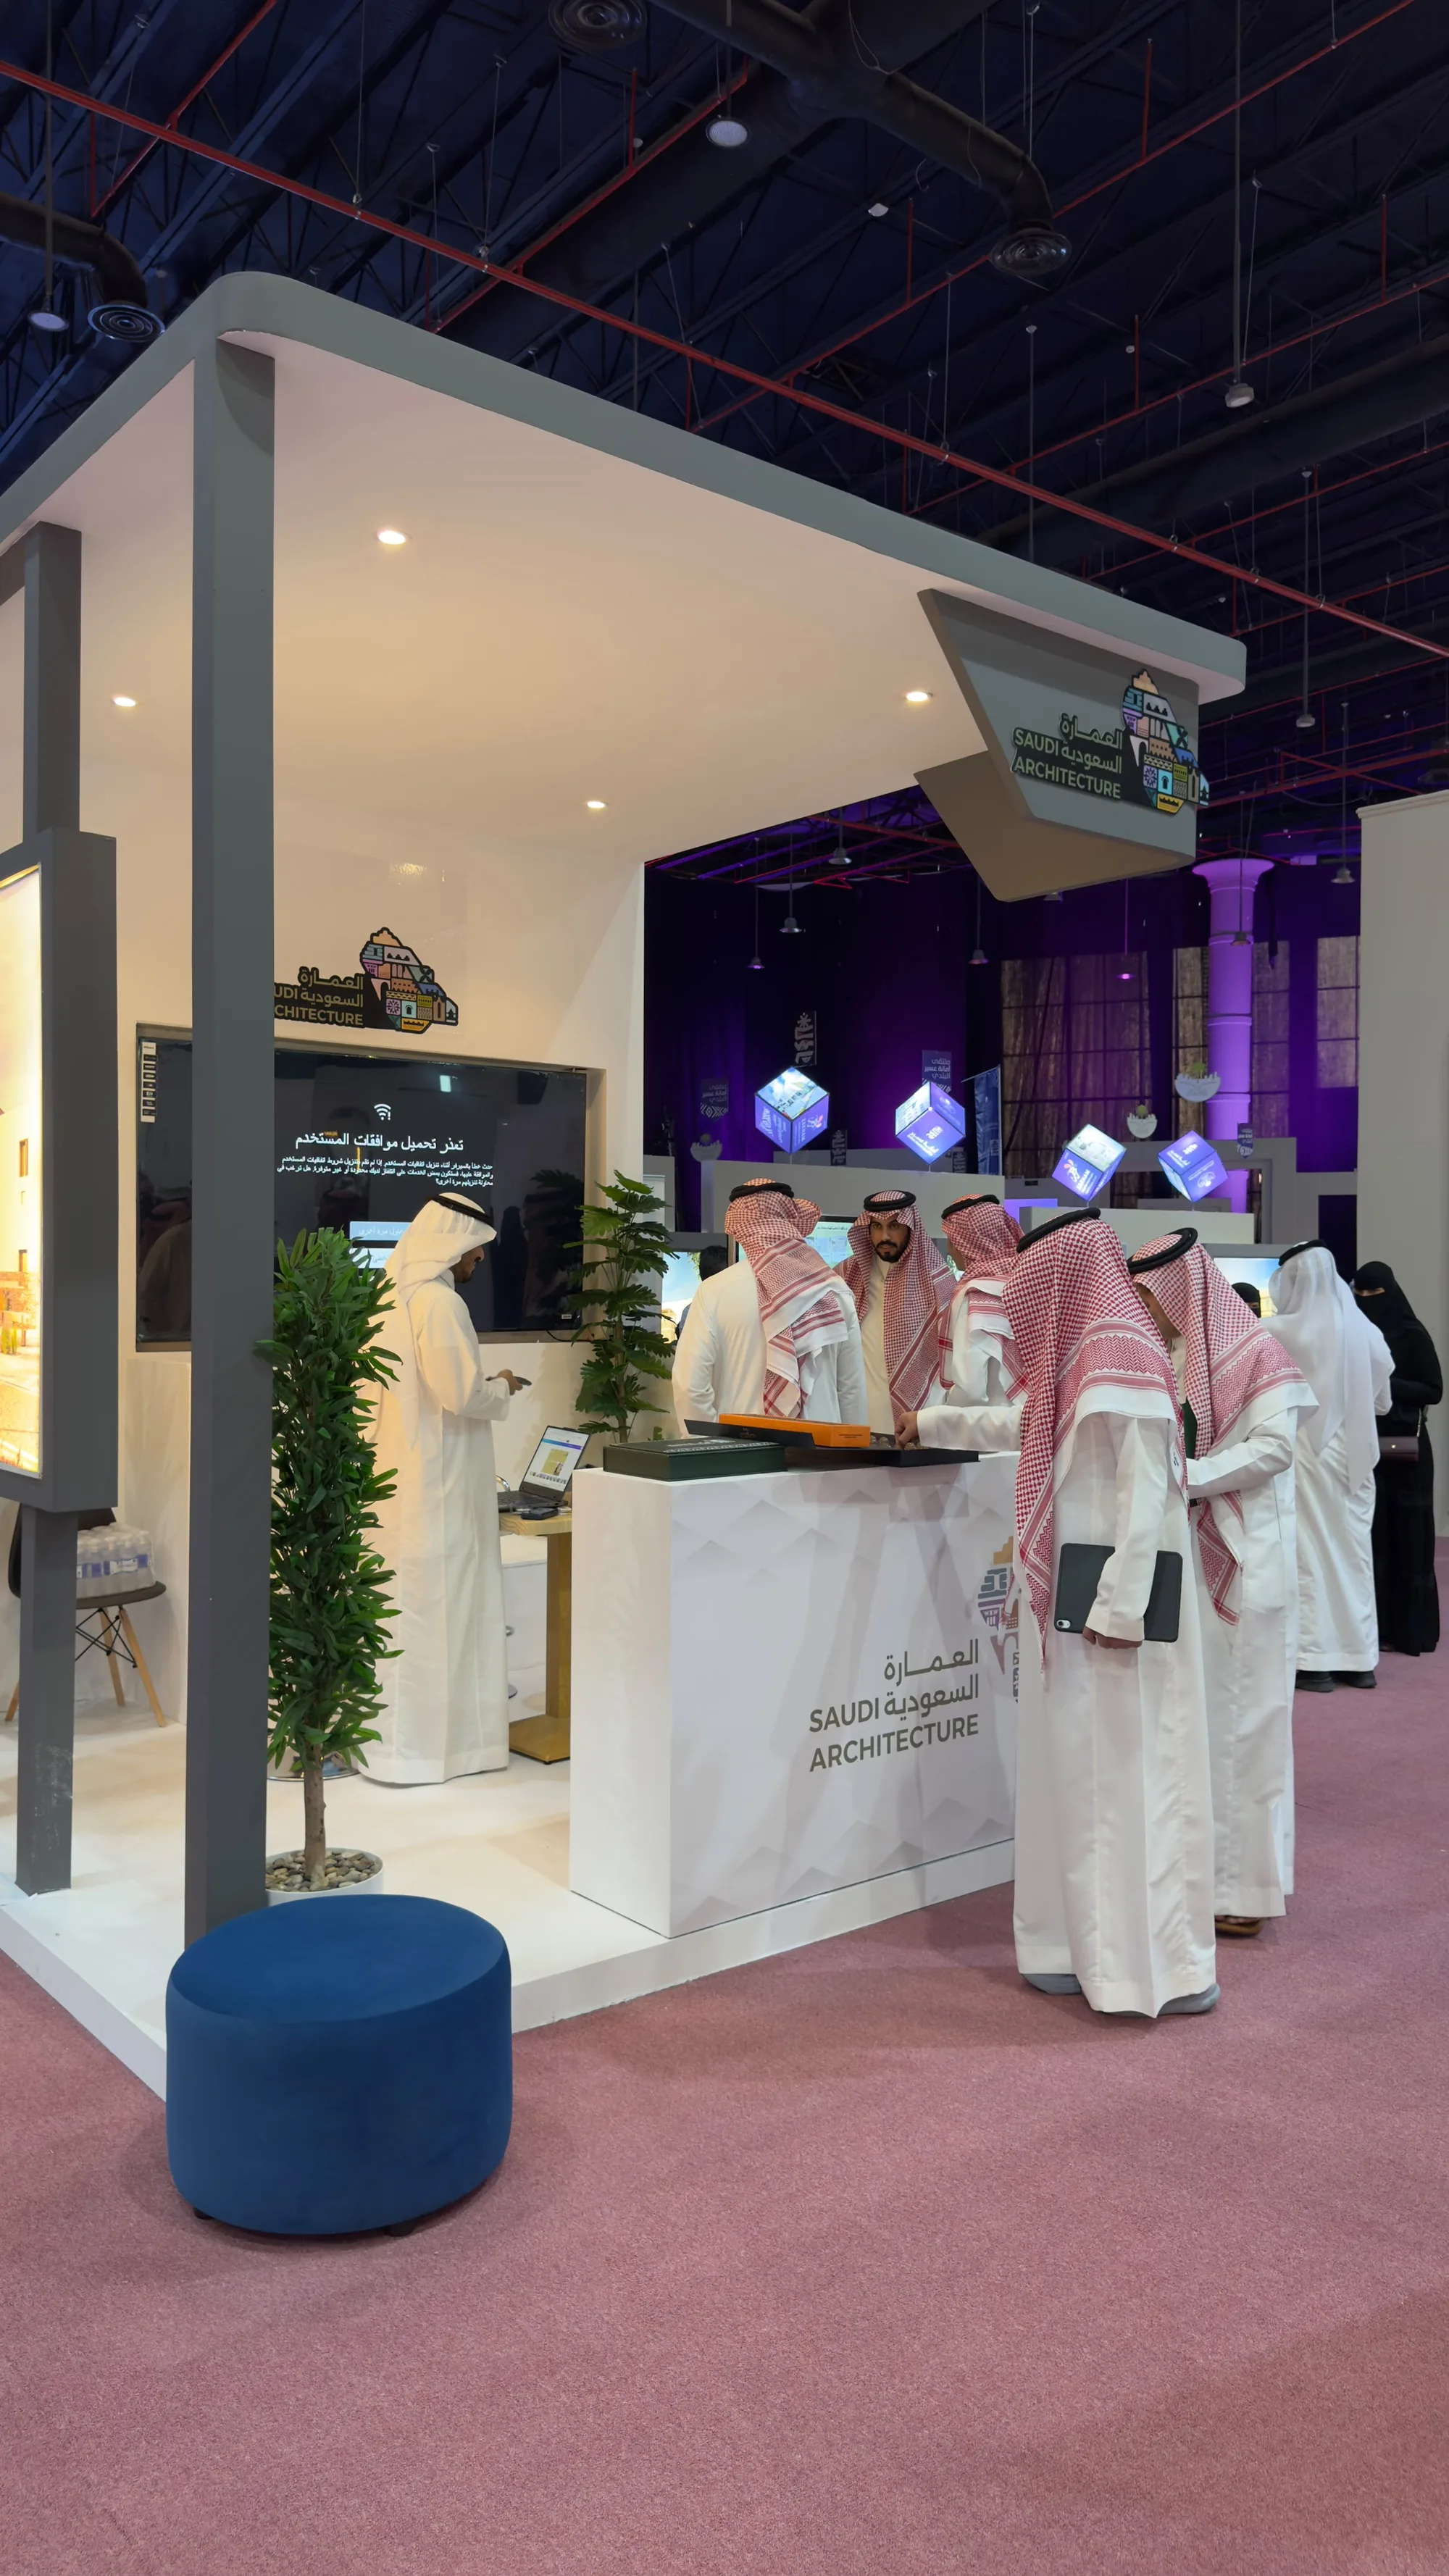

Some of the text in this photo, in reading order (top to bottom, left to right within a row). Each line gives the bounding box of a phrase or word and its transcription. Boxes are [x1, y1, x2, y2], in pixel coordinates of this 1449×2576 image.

[1015, 729, 1059, 756] SAUDI
[1061, 715, 1122, 750] العمارة
[1061, 740, 1122, 774] السعودية
[1014, 756, 1122, 799] ARCHITECTURE
[301, 969, 364, 990] العمارة
[274, 986, 298, 1000] UDI
[300, 987, 364, 1008] السعودية
[275, 1004, 364, 1026] CHITECTURE
[295, 1132, 464, 1154] تعذر تحميل موافقات المستخدم
[277, 1163, 285, 1173] في
[327, 1157, 343, 1166] شروط
[343, 1166, 350, 1174] أو
[361, 1158, 369, 1167] تقم
[462, 1179, 478, 1187] تنزيلهم
[478, 1179, 493, 1187] محاولة
[884, 1639, 979, 1687] العمارة
[884, 1673, 979, 1722] السعودية
[809, 1697, 879, 1733] SAUDI
[809, 1713, 979, 1772] ARCHITECTURE
